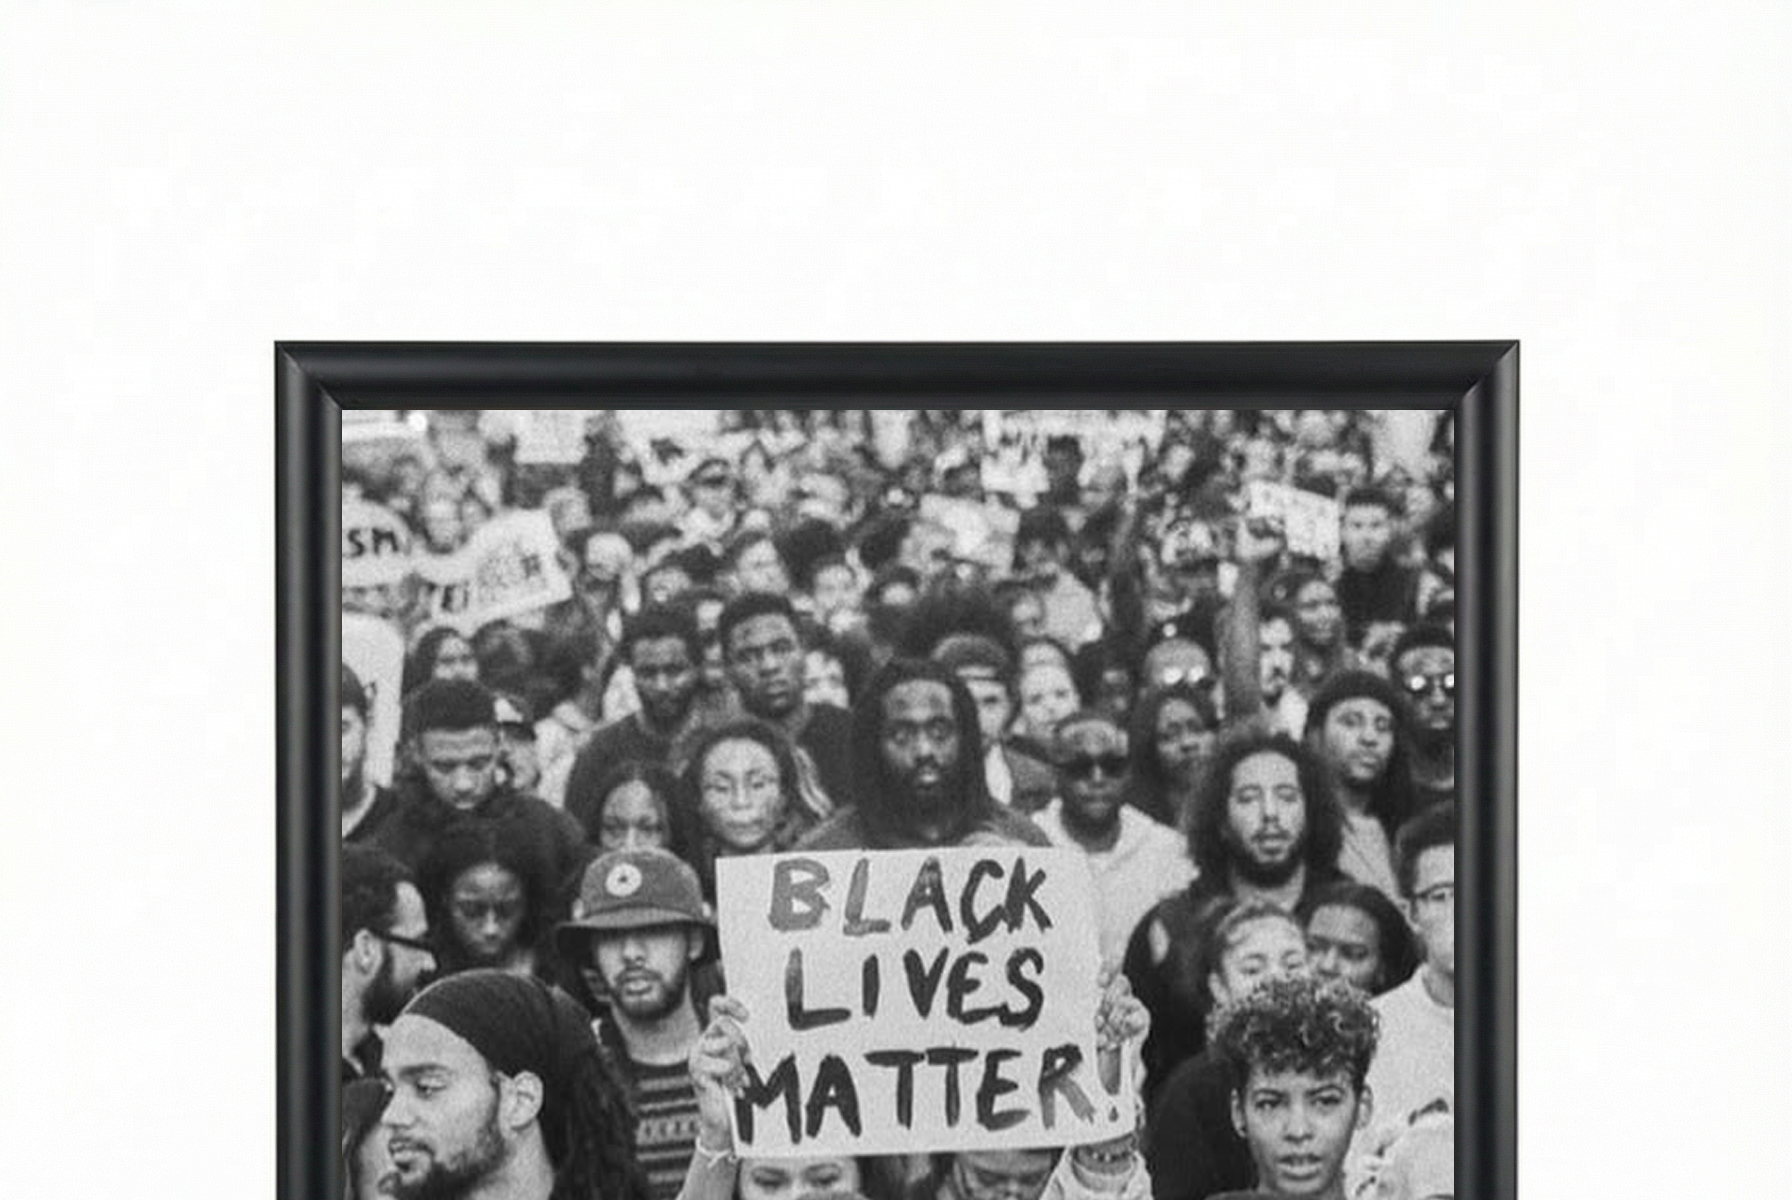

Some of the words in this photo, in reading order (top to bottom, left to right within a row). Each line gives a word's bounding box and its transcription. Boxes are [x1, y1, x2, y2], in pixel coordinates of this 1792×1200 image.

[769, 857, 1053, 943] BLACK
[785, 947, 1045, 1031] LIVES
[734, 1043, 1121, 1145] MATTER!
